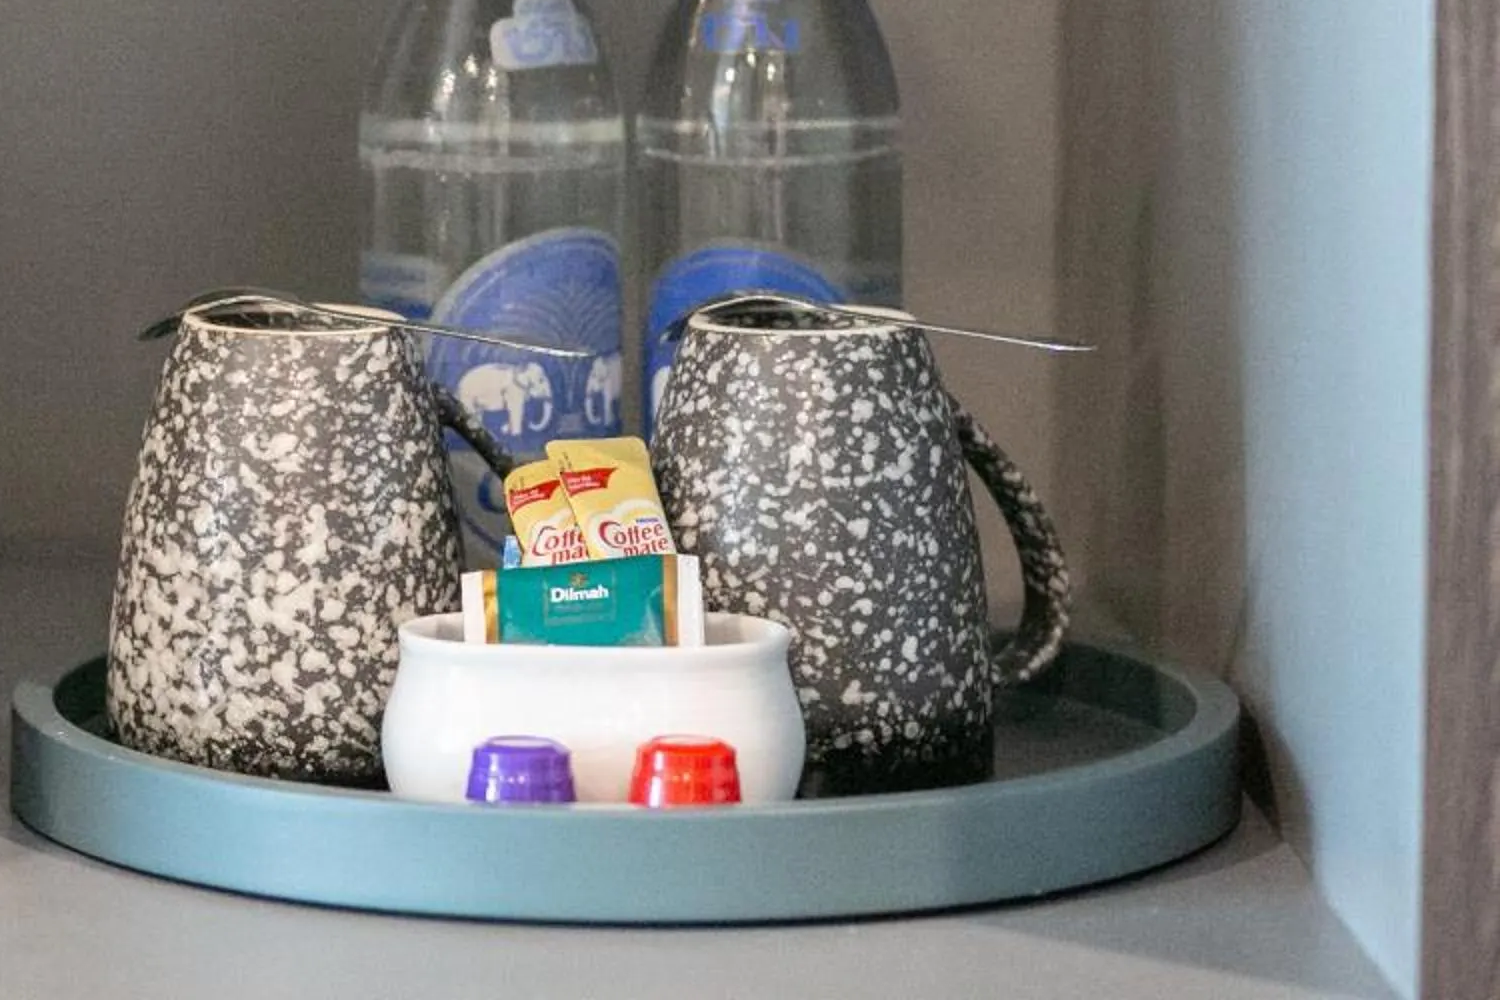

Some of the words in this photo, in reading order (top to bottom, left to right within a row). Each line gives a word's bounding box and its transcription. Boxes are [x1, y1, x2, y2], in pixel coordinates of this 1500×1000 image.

[531, 525, 584, 557] Coff
[598, 520, 664, 549] Coffee
[551, 545, 586, 567] ma
[622, 537, 669, 557] mate
[549, 584, 610, 603] Dilmah
